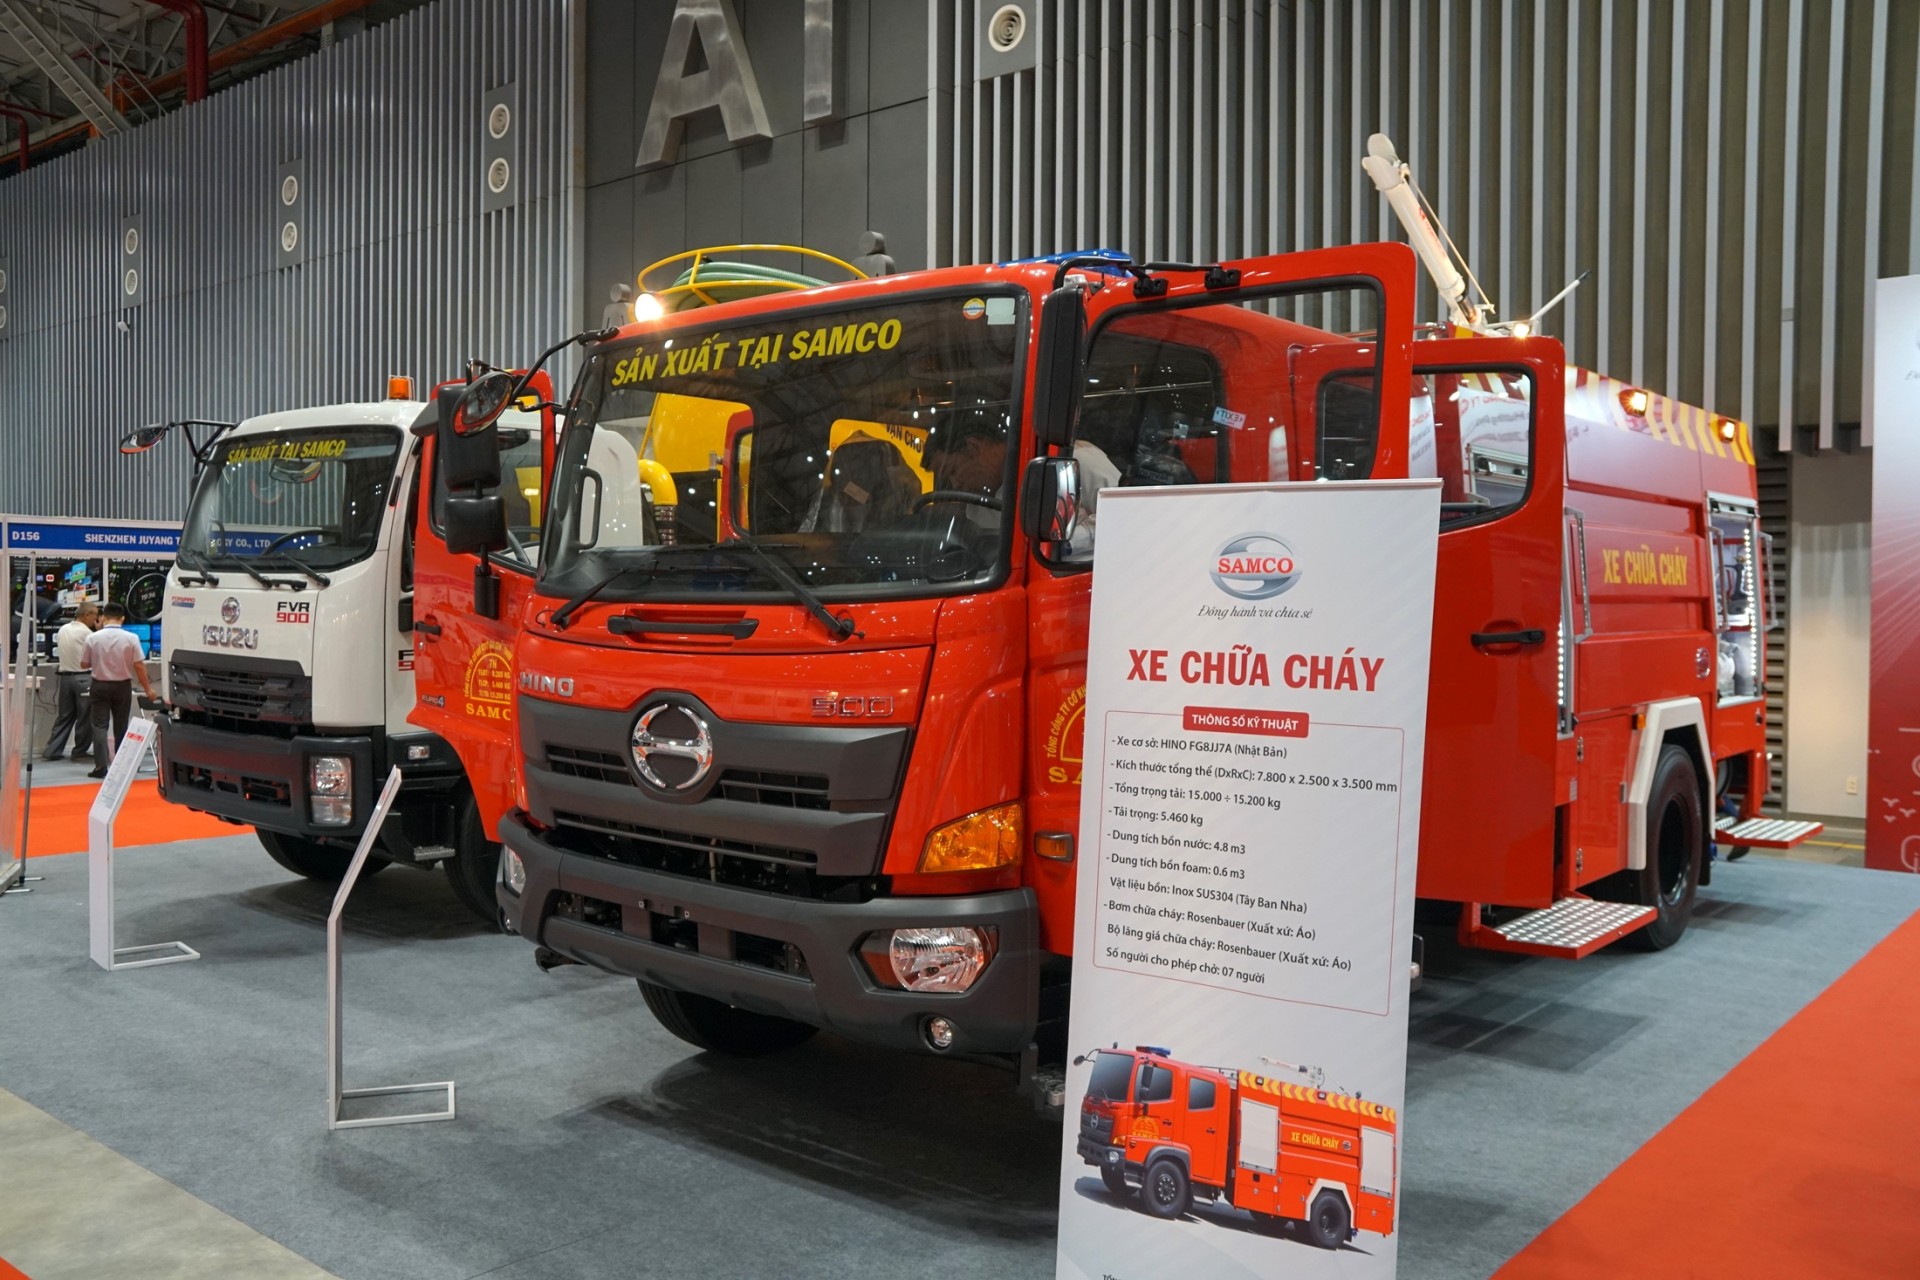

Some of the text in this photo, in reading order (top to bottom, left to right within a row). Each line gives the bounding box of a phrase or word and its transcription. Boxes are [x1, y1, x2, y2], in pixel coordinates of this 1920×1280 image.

[612, 318, 902, 386] SẢN XUẤT TẠI SAMCO
[250, 439, 278, 463] XUẤT
[279, 443, 300, 462] TẠI
[300, 439, 346, 458] SAMCO
[12, 531, 40, 541] D156
[85, 533, 136, 545] SHENZHEN
[138, 536, 173, 546] JUYANG
[1218, 557, 1294, 574] SAMCO
[1602, 543, 1687, 586] XE CHỮA CHÁY
[276, 612, 310, 623] 900
[277, 601, 310, 612] FVR
[1275, 606, 1299, 619] chia
[202, 624, 259, 650] ISUZU
[1127, 644, 1385, 692] XE CHỮA CHÁY
[520, 672, 574, 697] HINO
[811, 696, 894, 717] 500
[1191, 713, 1299, 733] THÔNG SỐ KỸ THUẬT
[1117, 736, 1288, 759] Xe cơ sở: HINO FG8JJ7A (Nhật Bản)
[1116, 759, 1398, 792] Kích thước tổng thể (DxRxC): 7.800 x 2.500 x 3.500 mm
[1114, 782, 1139, 797] Tổng
[1141, 785, 1168, 799] trọng
[1170, 788, 1186, 799] tải:
[1188, 790, 1222, 802] 15.000
[1233, 794, 1265, 807] 15.200
[1267, 797, 1281, 811] kg
[1113, 806, 1203, 827] Tải trọng: 5.460 kg
[1112, 829, 1139, 844] Dung
[1141, 833, 1159, 845] tích
[1183, 838, 1212, 850] nước:
[1213, 842, 1229, 853] 4.8
[1230, 844, 1246, 855] m3
[1111, 853, 1138, 868] Dung
[1140, 856, 1158, 868] tích
[1182, 862, 1211, 875] foam:
[1213, 866, 1228, 877] 0.6
[1229, 869, 1245, 879] m3
[1110, 877, 1126, 890] Vật
[1128, 878, 1146, 892] liệu
[1172, 885, 1194, 897] Inox
[1196, 888, 1234, 903] SUS304
[1235, 893, 1256, 908] (Tây
[1258, 897, 1278, 910] Ban
[1280, 900, 1308, 914] Nha)
[1108, 900, 1316, 941] Bơm chữa cháy: Rosenbauer (Xuất xứ: Áo)
[1107, 923, 1352, 972] Bộ lăng giá chữa cháy: Rosenbauer (Xuất xứ: Áo)
[1106, 946, 1265, 984] Số người cho phép chở: 07 người
[1291, 1131, 1340, 1149] XE CHỮA CHÁY
